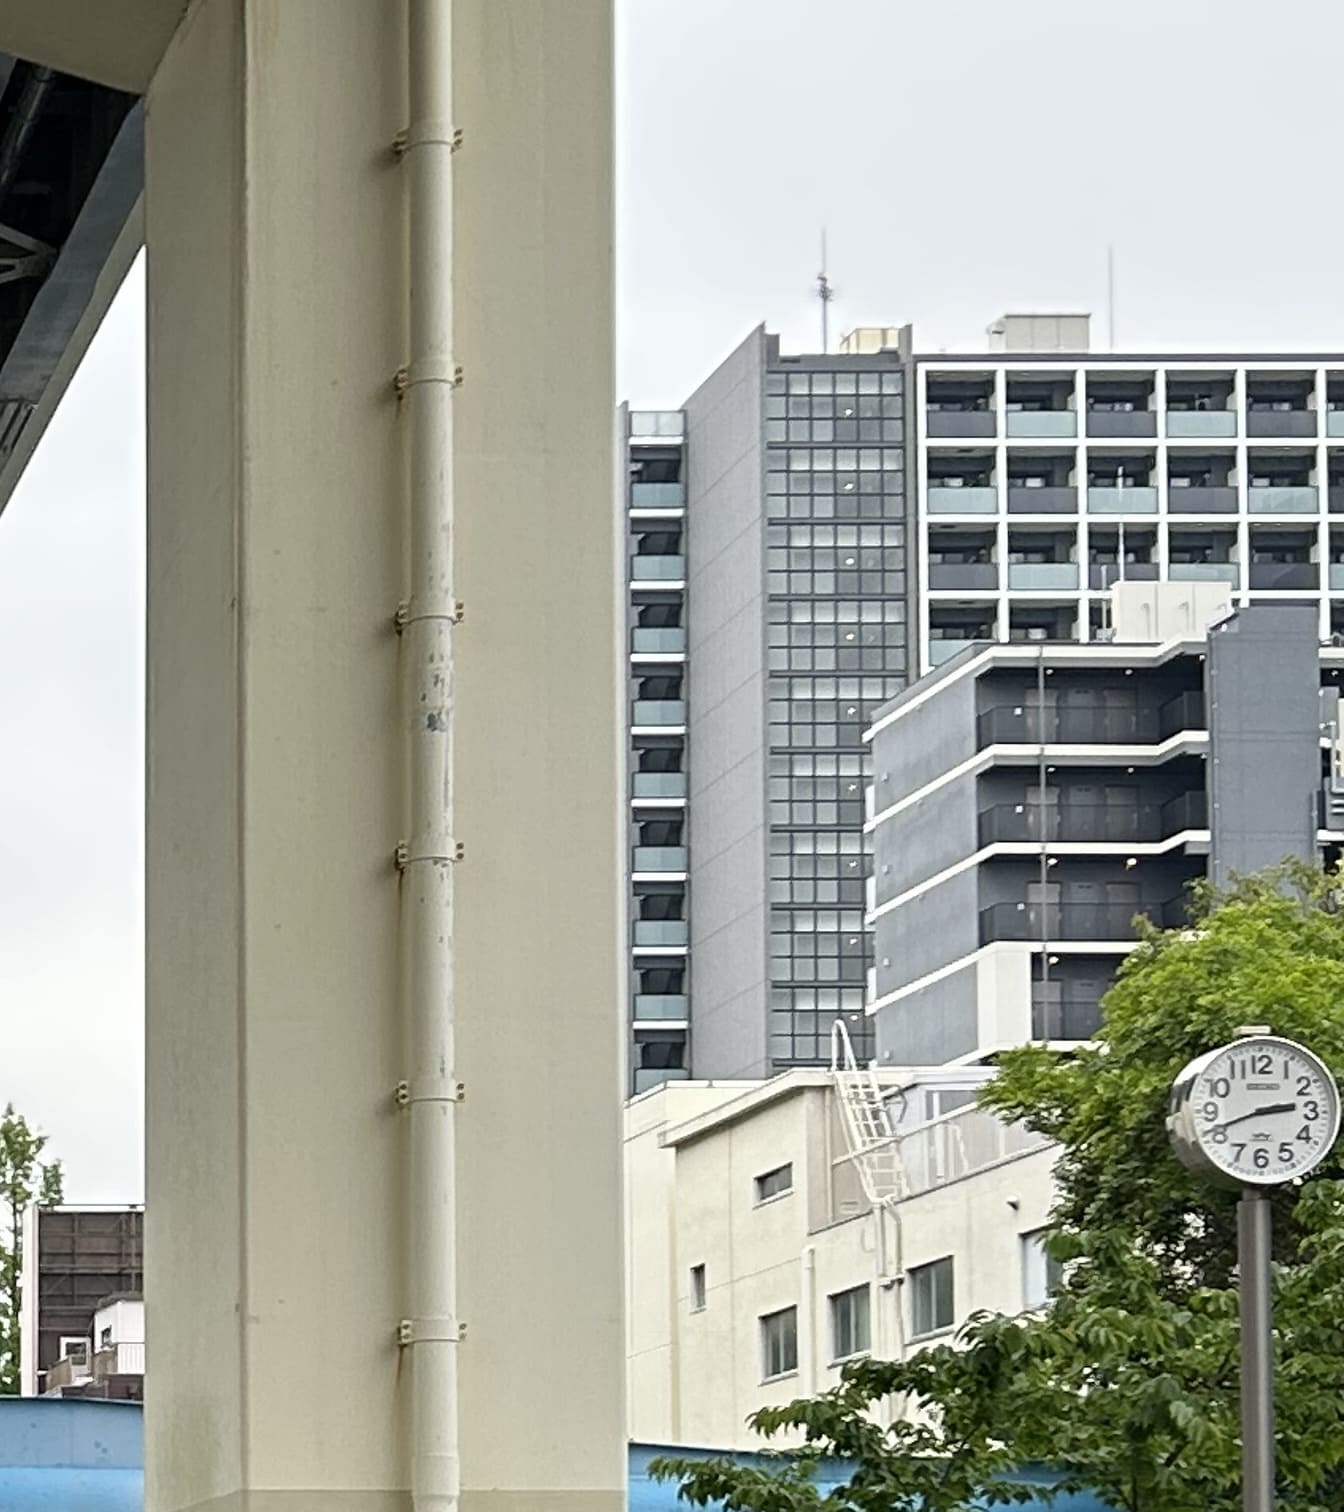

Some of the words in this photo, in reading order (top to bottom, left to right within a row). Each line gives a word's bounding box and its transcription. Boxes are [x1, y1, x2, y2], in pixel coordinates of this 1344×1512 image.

[1230, 1060, 1246, 1080] 11
[1252, 1055, 1273, 1075] 12
[1284, 1060, 1289, 1080] 1
[1209, 1078, 1230, 1098] 10
[1296, 1076, 1311, 1096] 2
[1204, 1102, 1218, 1121] 9
[1303, 1101, 1319, 1121] 3
[1213, 1124, 1227, 1144] 8
[1296, 1125, 1312, 1143] 4
[1230, 1143, 1247, 1162] 7
[1253, 1148, 1269, 1168] 6
[1278, 1142, 1294, 1162] 5
